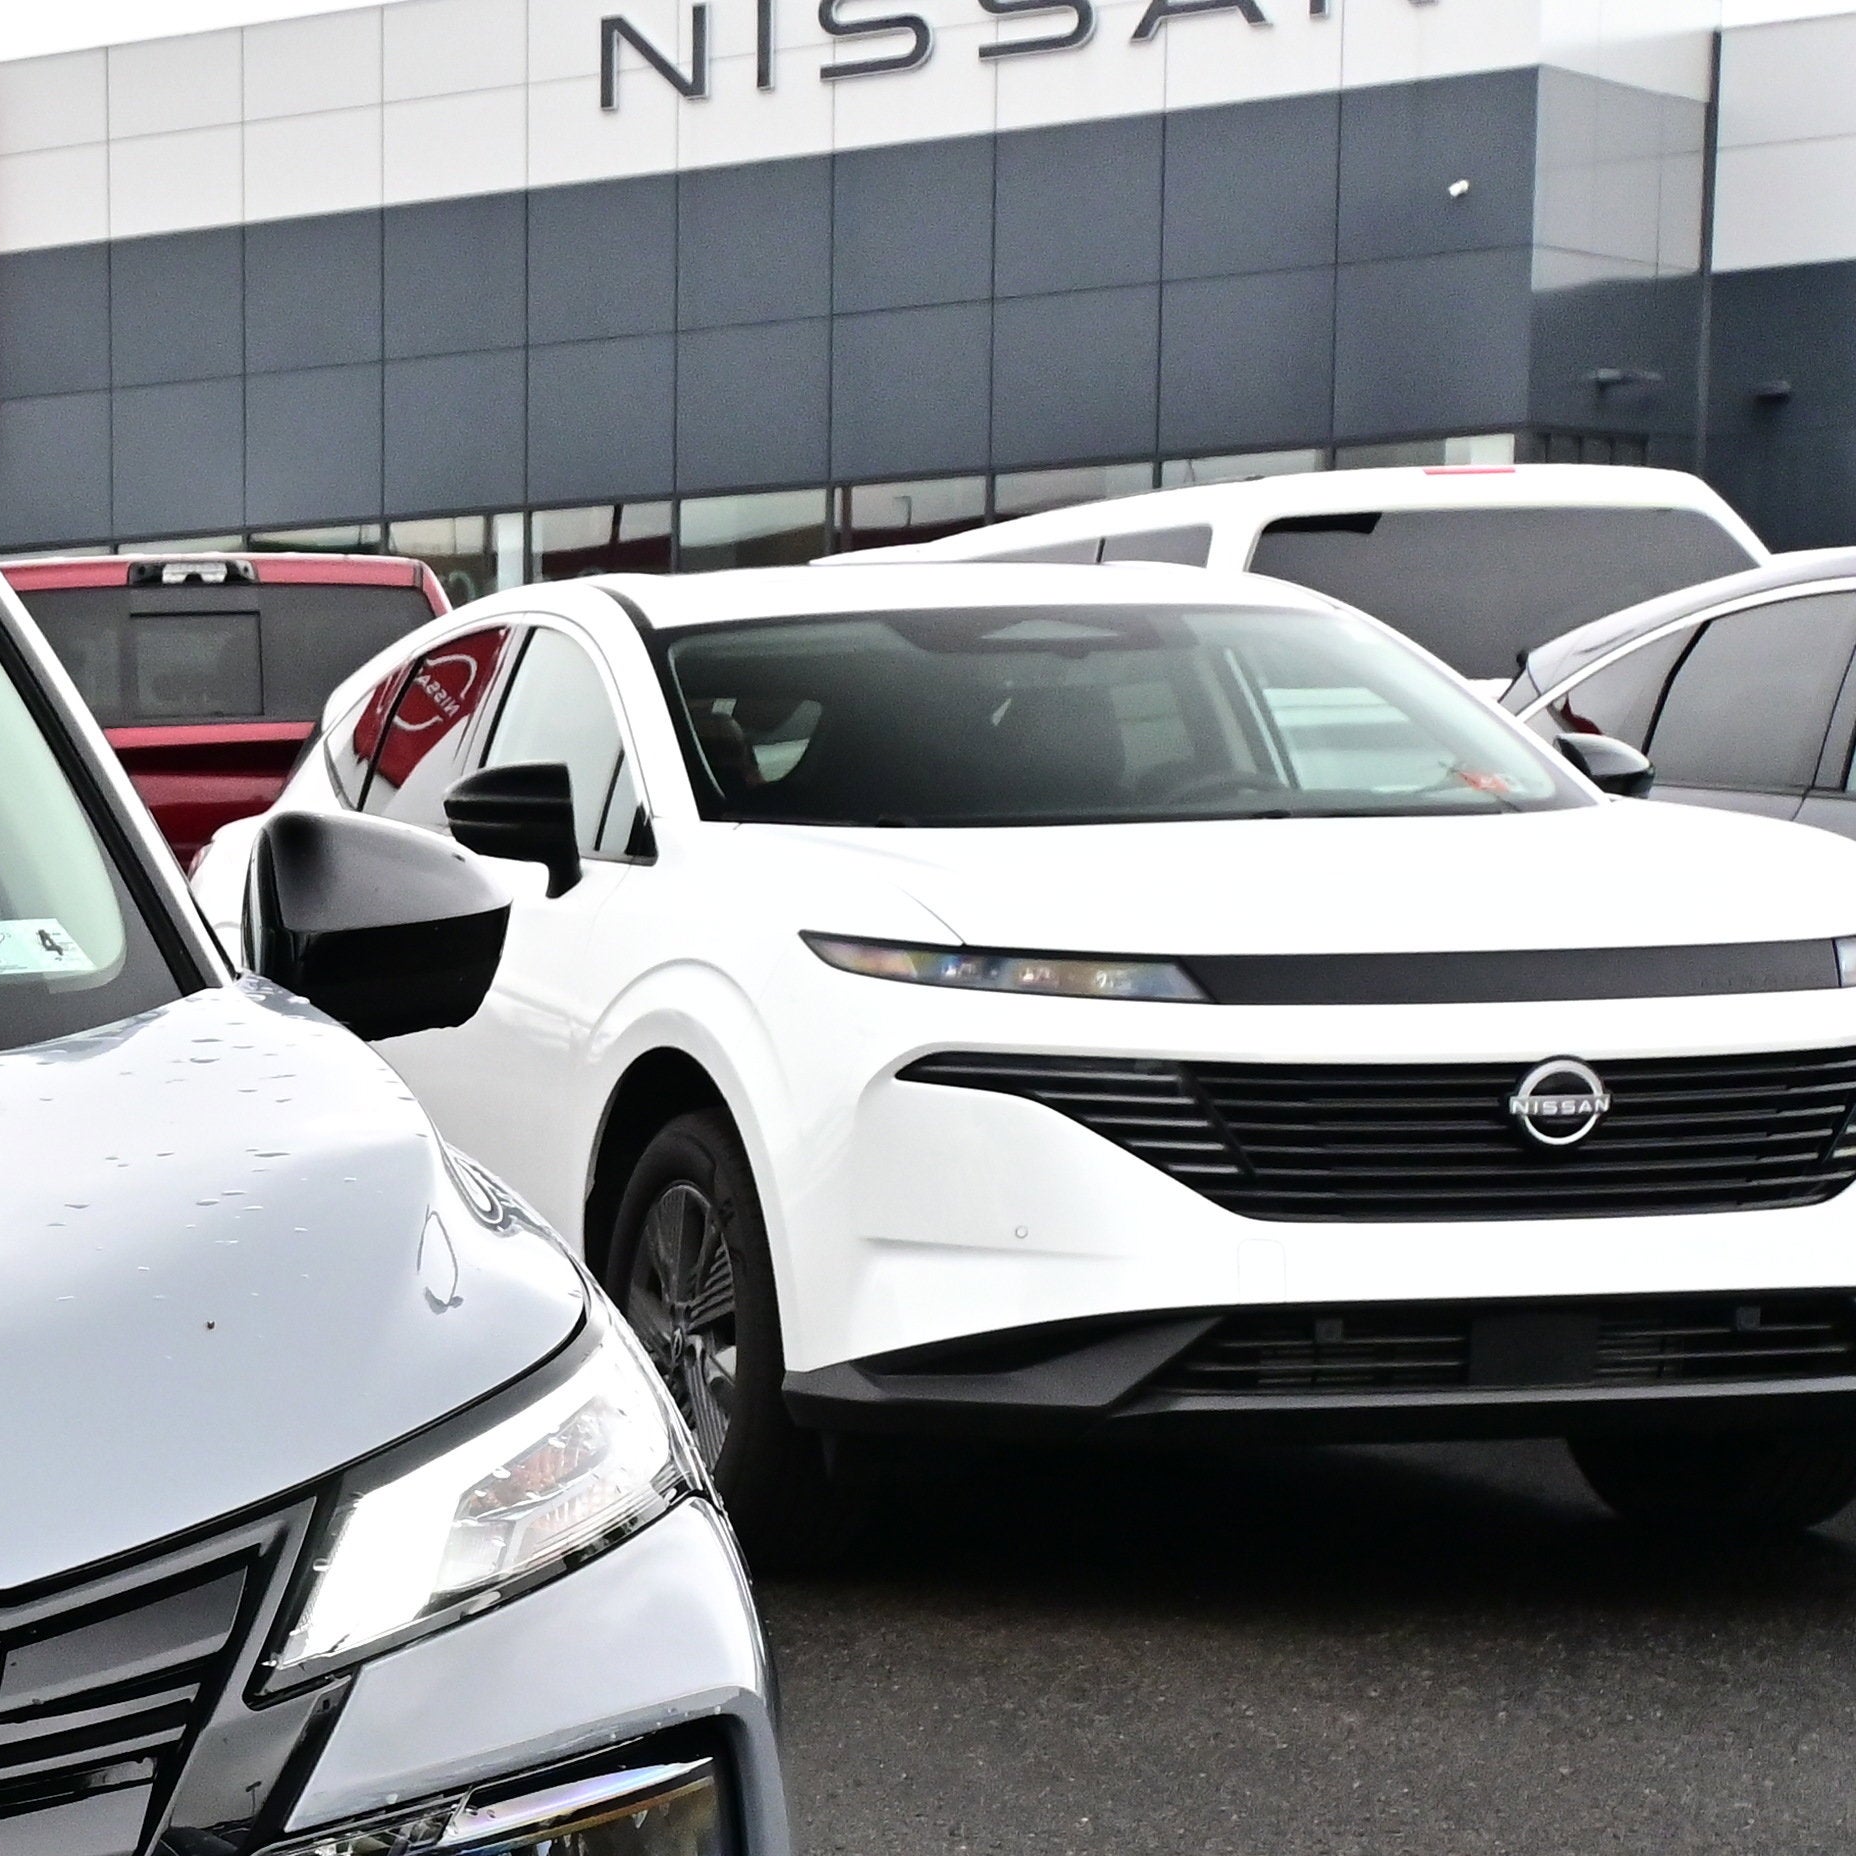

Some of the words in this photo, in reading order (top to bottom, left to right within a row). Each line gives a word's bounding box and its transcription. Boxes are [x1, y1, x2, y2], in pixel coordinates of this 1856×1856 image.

[599, 0, 1436, 112] NISS
[37, 928, 64, 956] 4
[1511, 1097, 1609, 1116] NISSAN
